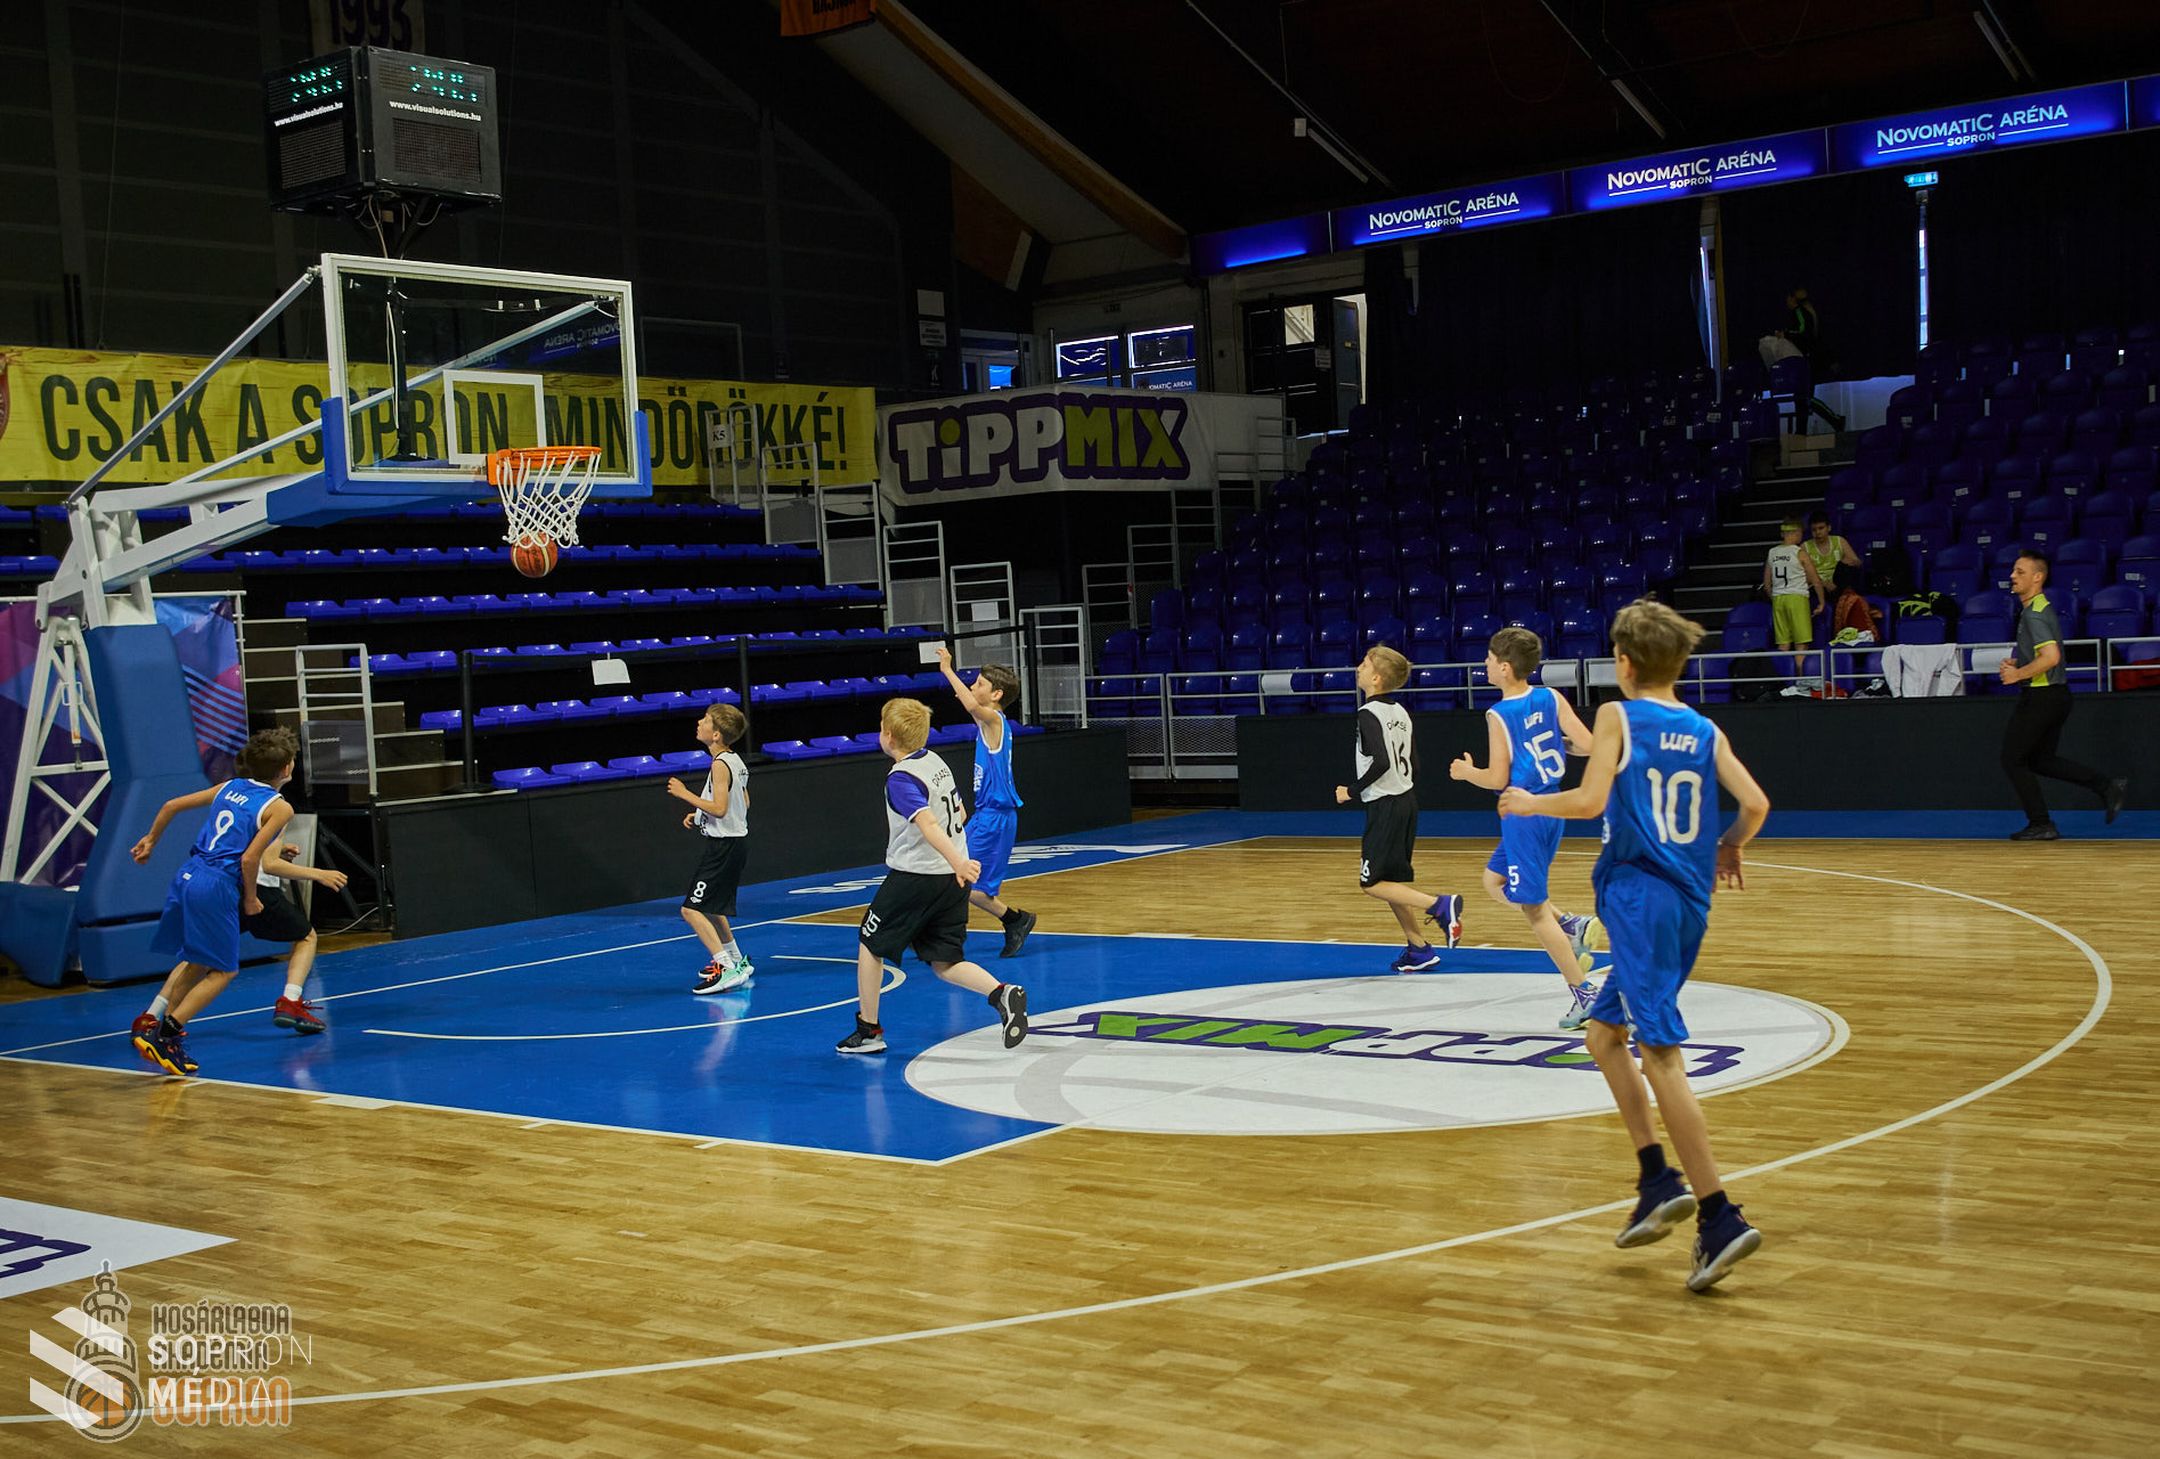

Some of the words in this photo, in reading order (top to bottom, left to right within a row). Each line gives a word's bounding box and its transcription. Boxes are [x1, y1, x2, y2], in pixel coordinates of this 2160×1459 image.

[389, 100, 482, 121] www.visualsolutions.hu
[1876, 113, 1994, 148] NOVOMATIC
[1999, 104, 2068, 128] ARÉNA
[1946, 131, 1995, 147] SOPRON
[1607, 158, 1711, 190] NOVOMATIC
[1715, 150, 1776, 172] ARÉNA
[1669, 175, 1713, 189] SOPRON
[1369, 200, 1461, 230] NOVOMATIC
[1465, 192, 1520, 213] ARÉNA
[1424, 216, 1463, 229] SOPRON
[40, 374, 216, 464] CSAK
[236, 383, 274, 464] A
[1774, 566, 1788, 586] 4
[1523, 711, 1543, 729] LUFI
[1523, 730, 1566, 785] 15
[1659, 731, 1699, 754] LUFI
[1391, 740, 1408, 777] 16
[225, 790, 249, 806] LUFI
[940, 786, 962, 838] 15
[1646, 767, 1703, 845] 10
[208, 809, 235, 851] 9
[693, 880, 707, 898] 8
